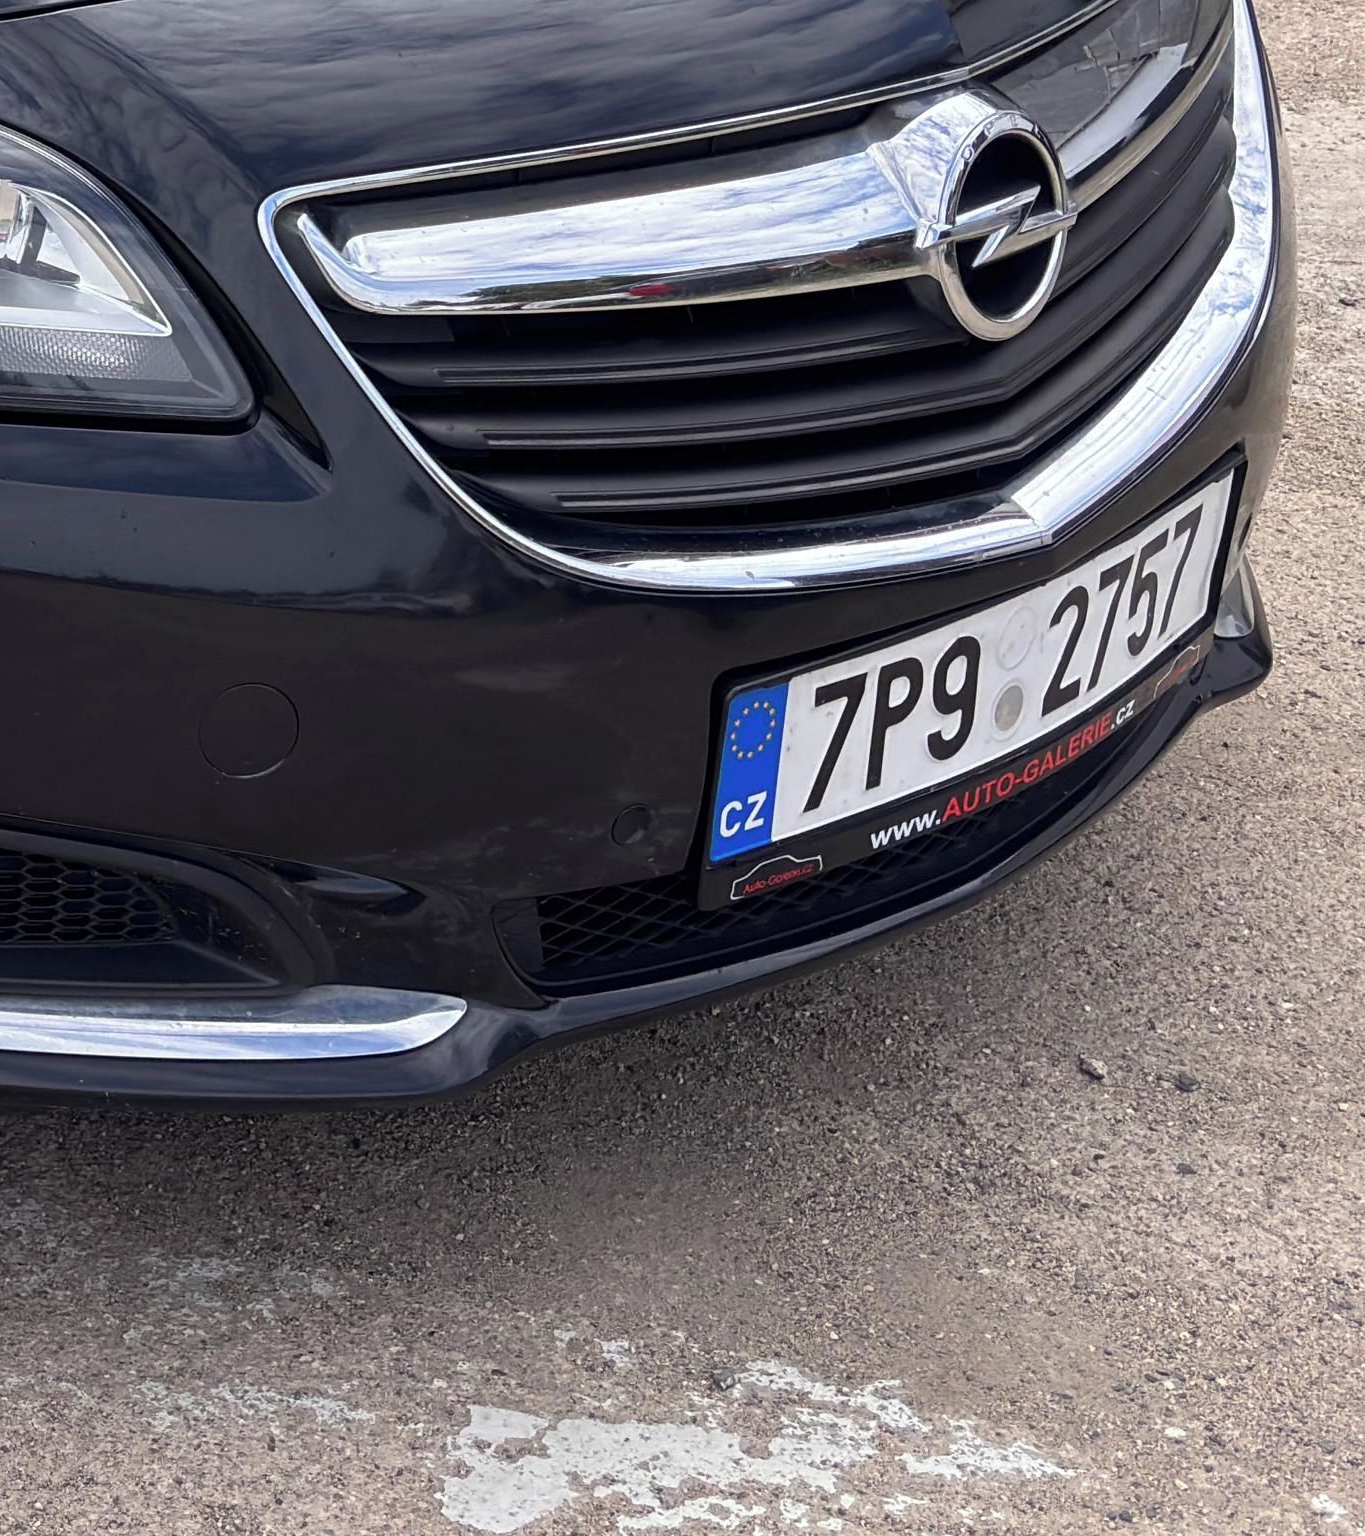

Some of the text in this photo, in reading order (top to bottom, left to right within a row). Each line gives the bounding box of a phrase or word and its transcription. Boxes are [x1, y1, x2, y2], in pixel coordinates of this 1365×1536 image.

[961, 113, 1043, 162] OPEL
[802, 504, 1205, 813] 7P9 2757
[720, 791, 769, 838] CZ
